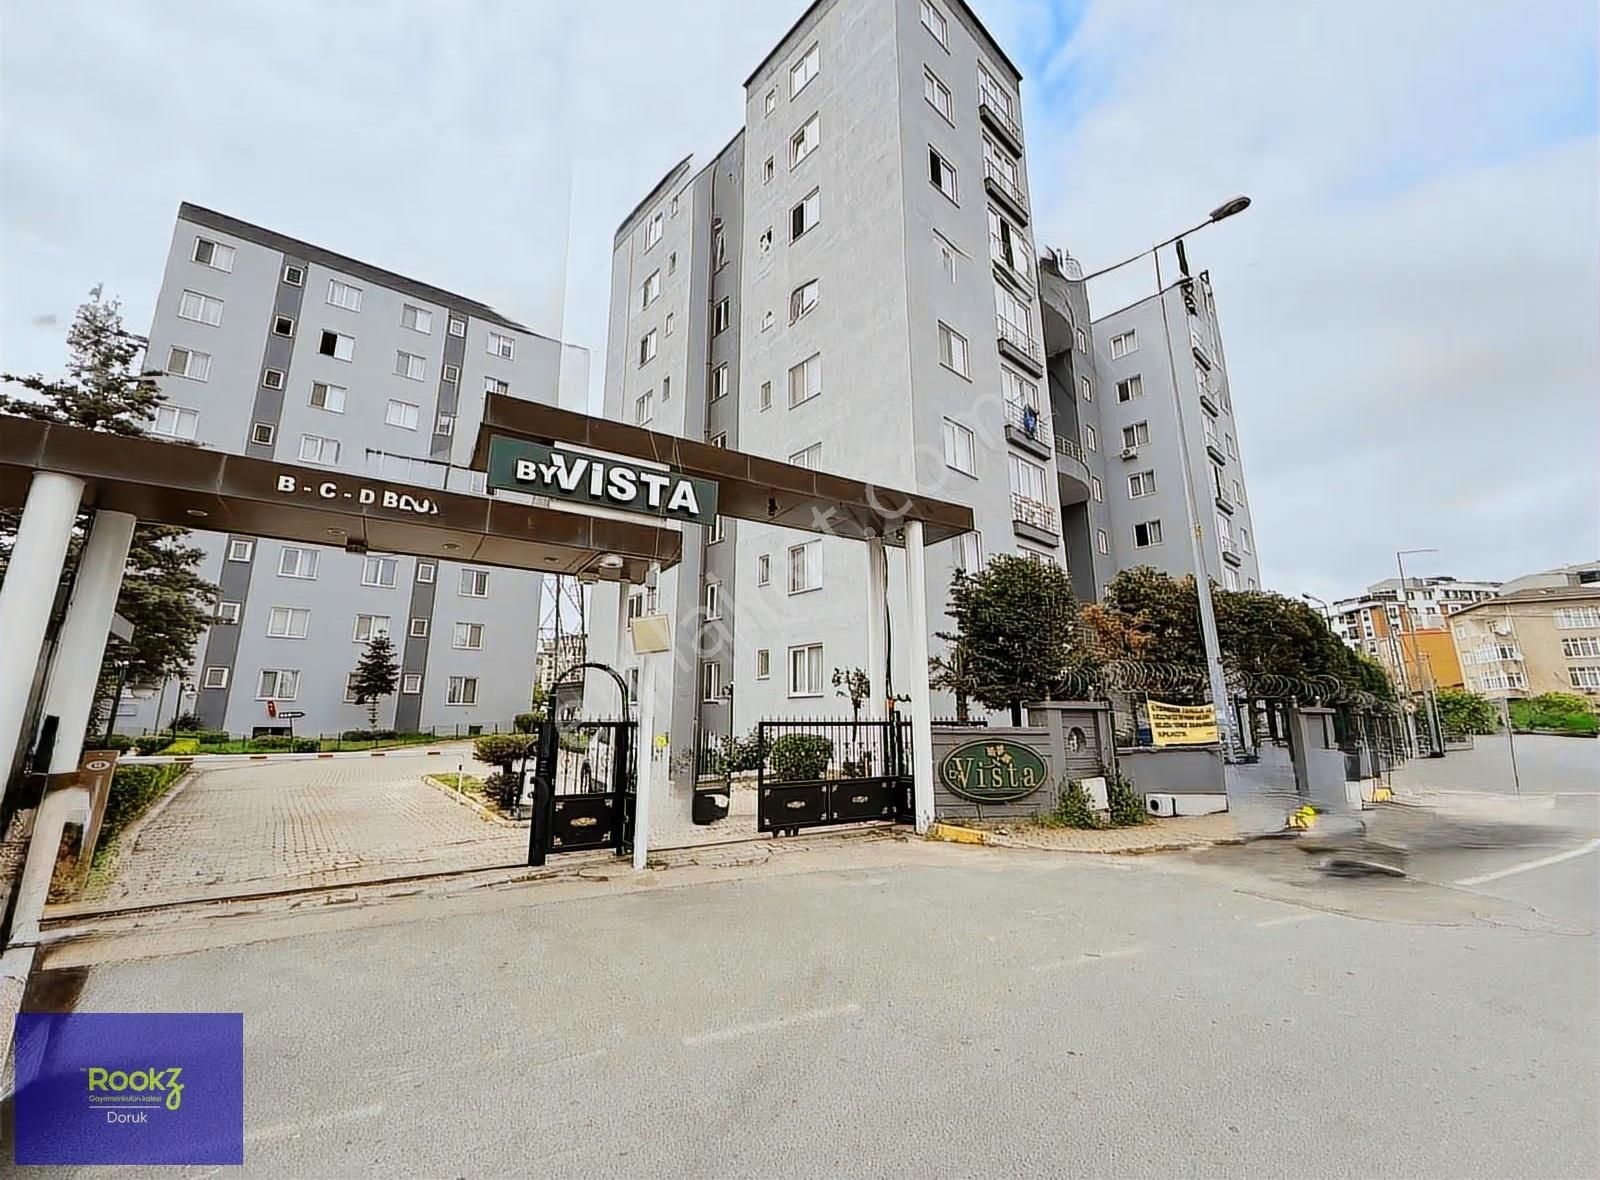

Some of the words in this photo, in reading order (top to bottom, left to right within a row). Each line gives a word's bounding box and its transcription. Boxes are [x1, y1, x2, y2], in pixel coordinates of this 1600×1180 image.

[277, 475, 296, 492] B
[319, 482, 337, 498] C
[359, 488, 376, 504] D
[516, 459, 558, 484] BY
[551, 453, 700, 514] VISTA
[952, 757, 1037, 789] Vista
